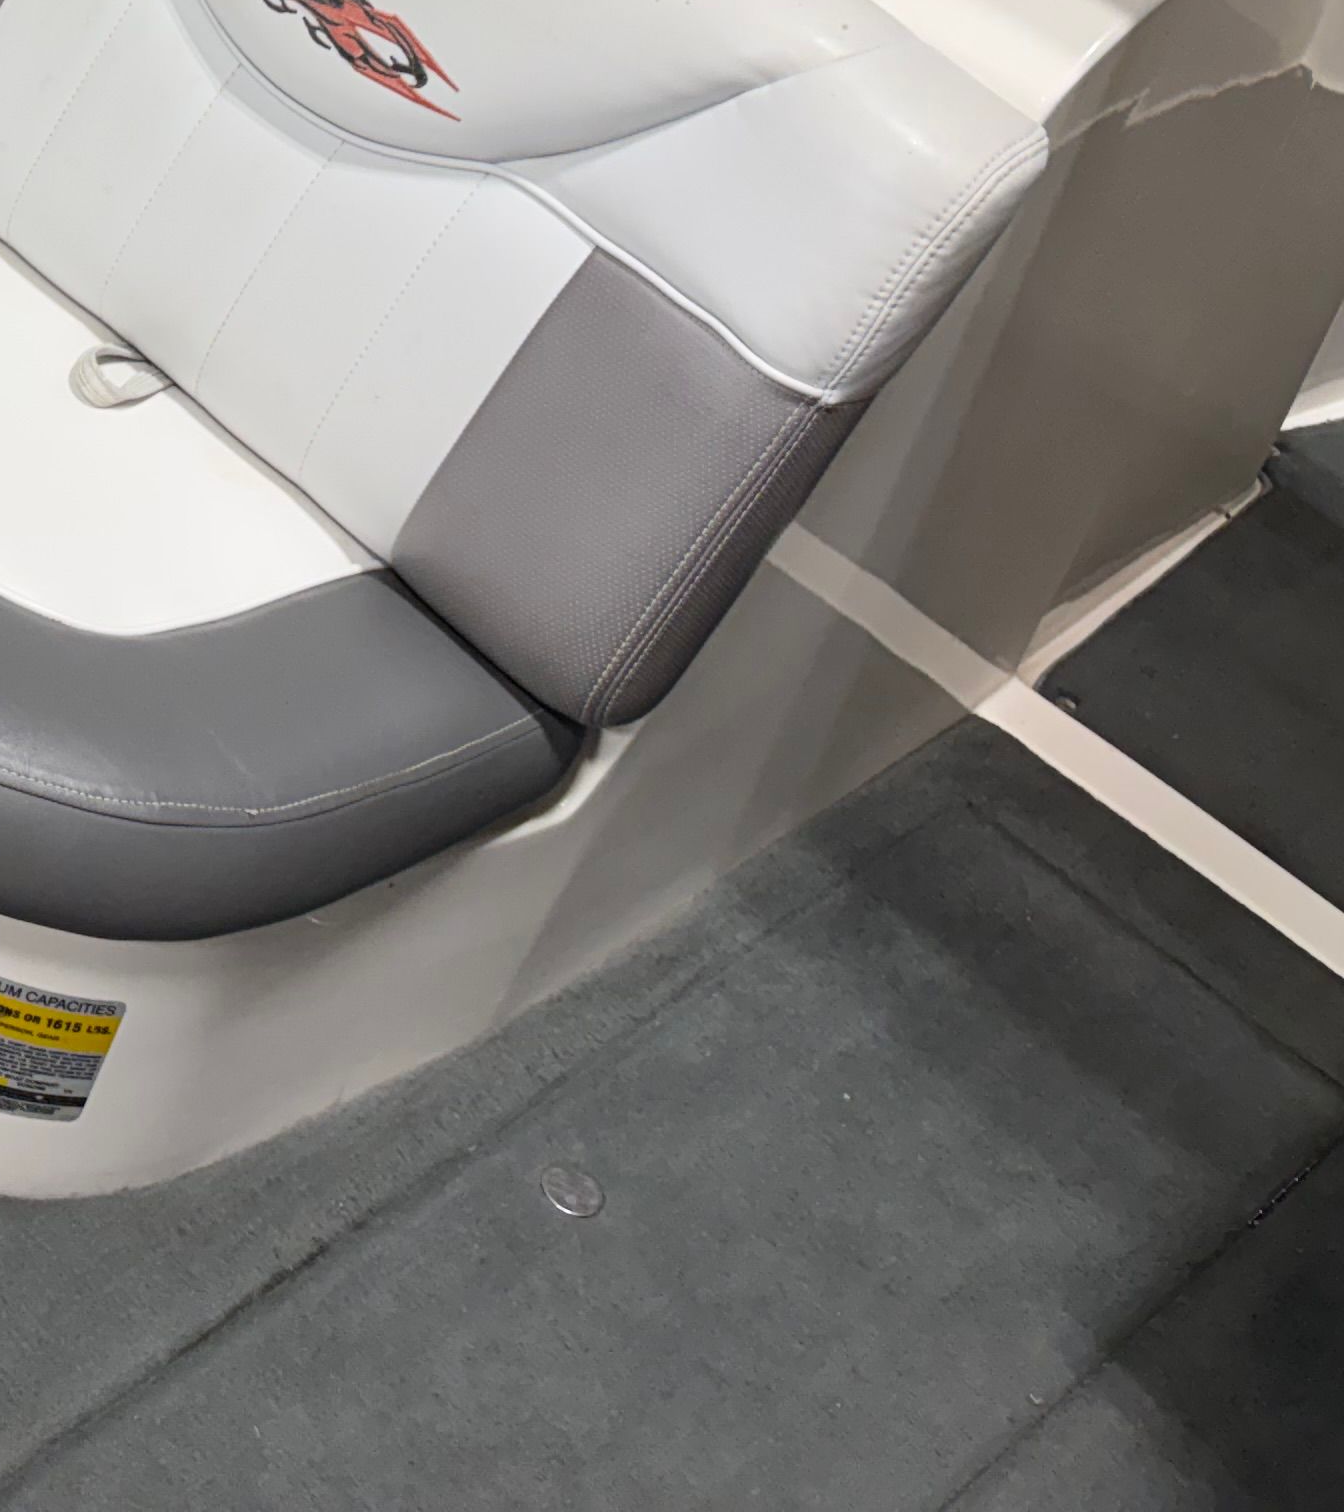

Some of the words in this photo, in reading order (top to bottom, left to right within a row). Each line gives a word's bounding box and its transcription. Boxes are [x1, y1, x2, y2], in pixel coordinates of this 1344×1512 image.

[25, 990, 117, 1017] CAPACITIES
[23, 1013, 41, 1025] OR
[46, 1017, 83, 1033] 1615
